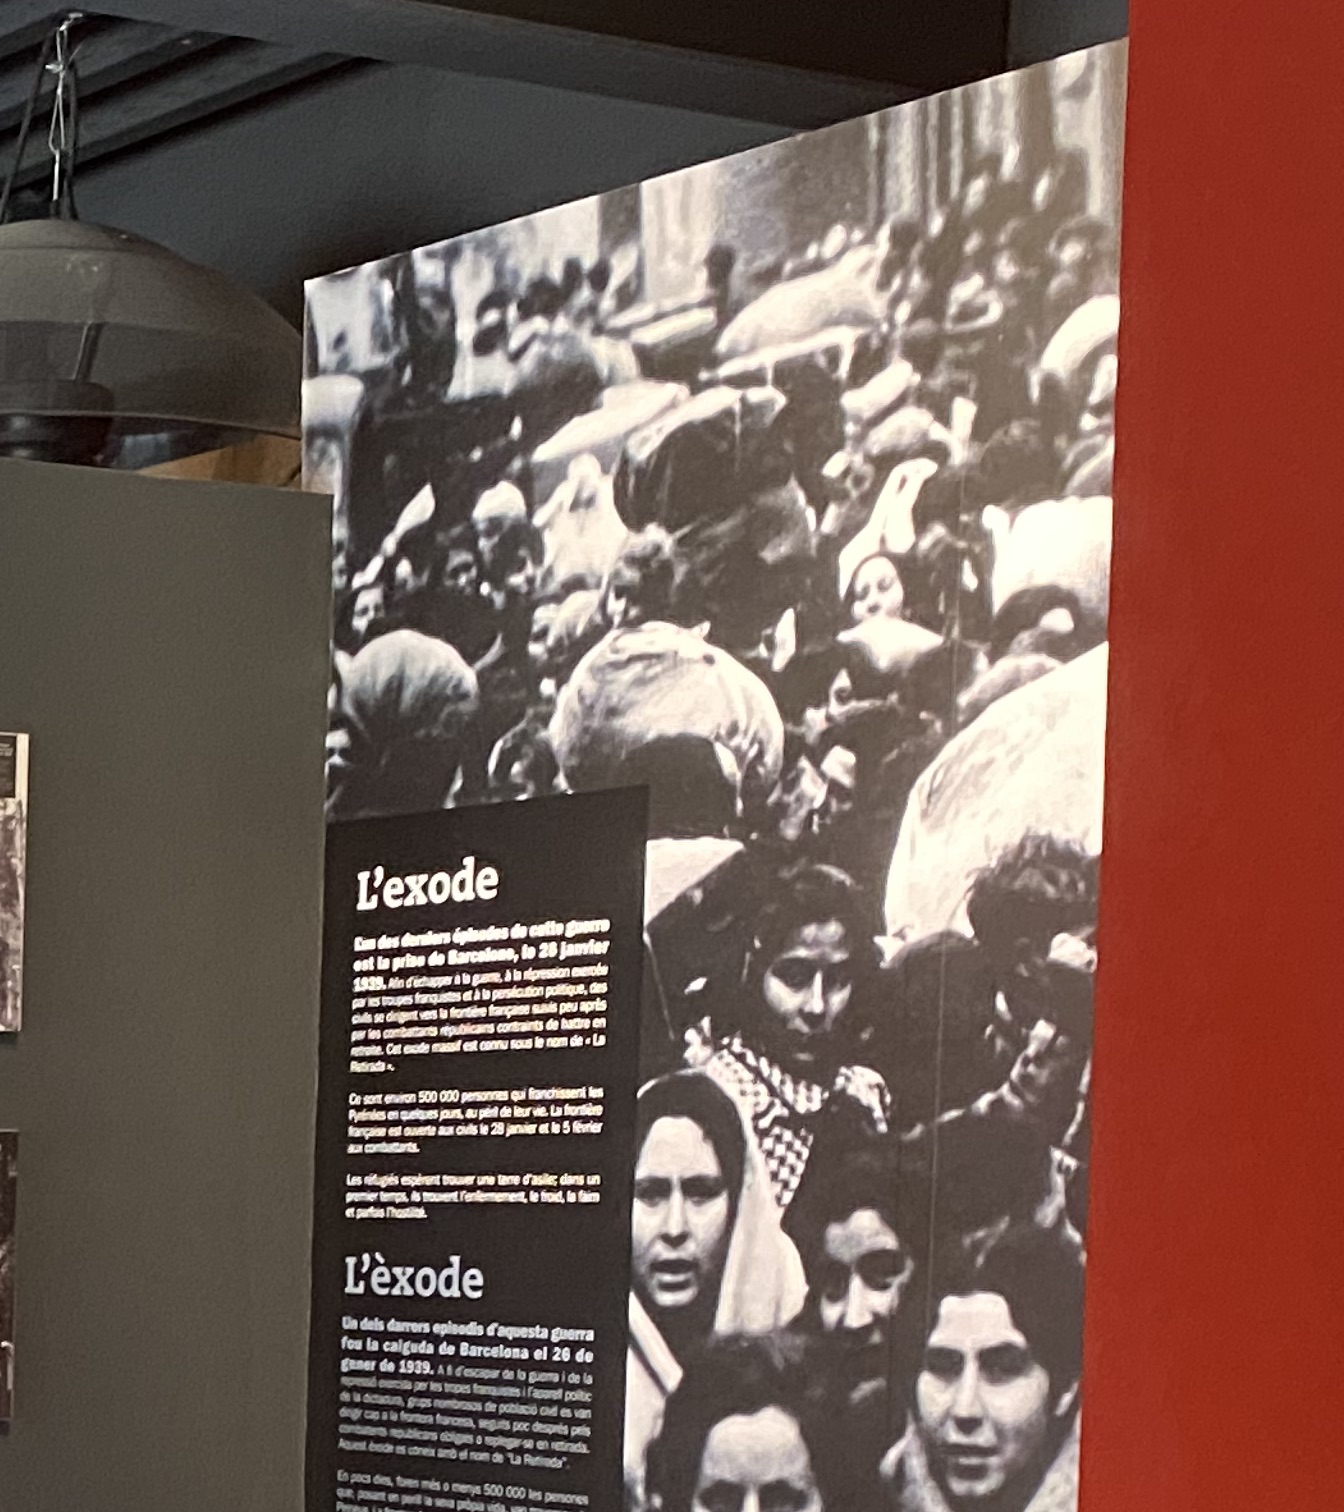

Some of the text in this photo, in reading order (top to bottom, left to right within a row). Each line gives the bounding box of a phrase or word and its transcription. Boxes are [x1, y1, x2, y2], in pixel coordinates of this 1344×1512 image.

[356, 855, 499, 911] L'exode
[418, 1090, 438, 1103] 500
[344, 1251, 484, 1299] L'èxode
[340, 1336, 362, 1350] fou
[366, 1337, 379, 1351] la
[438, 1341, 456, 1355] de
[459, 1342, 529, 1359] Barcelona
[533, 1346, 548, 1360] el
[551, 1346, 571, 1362] 26
[574, 1347, 594, 1363] de
